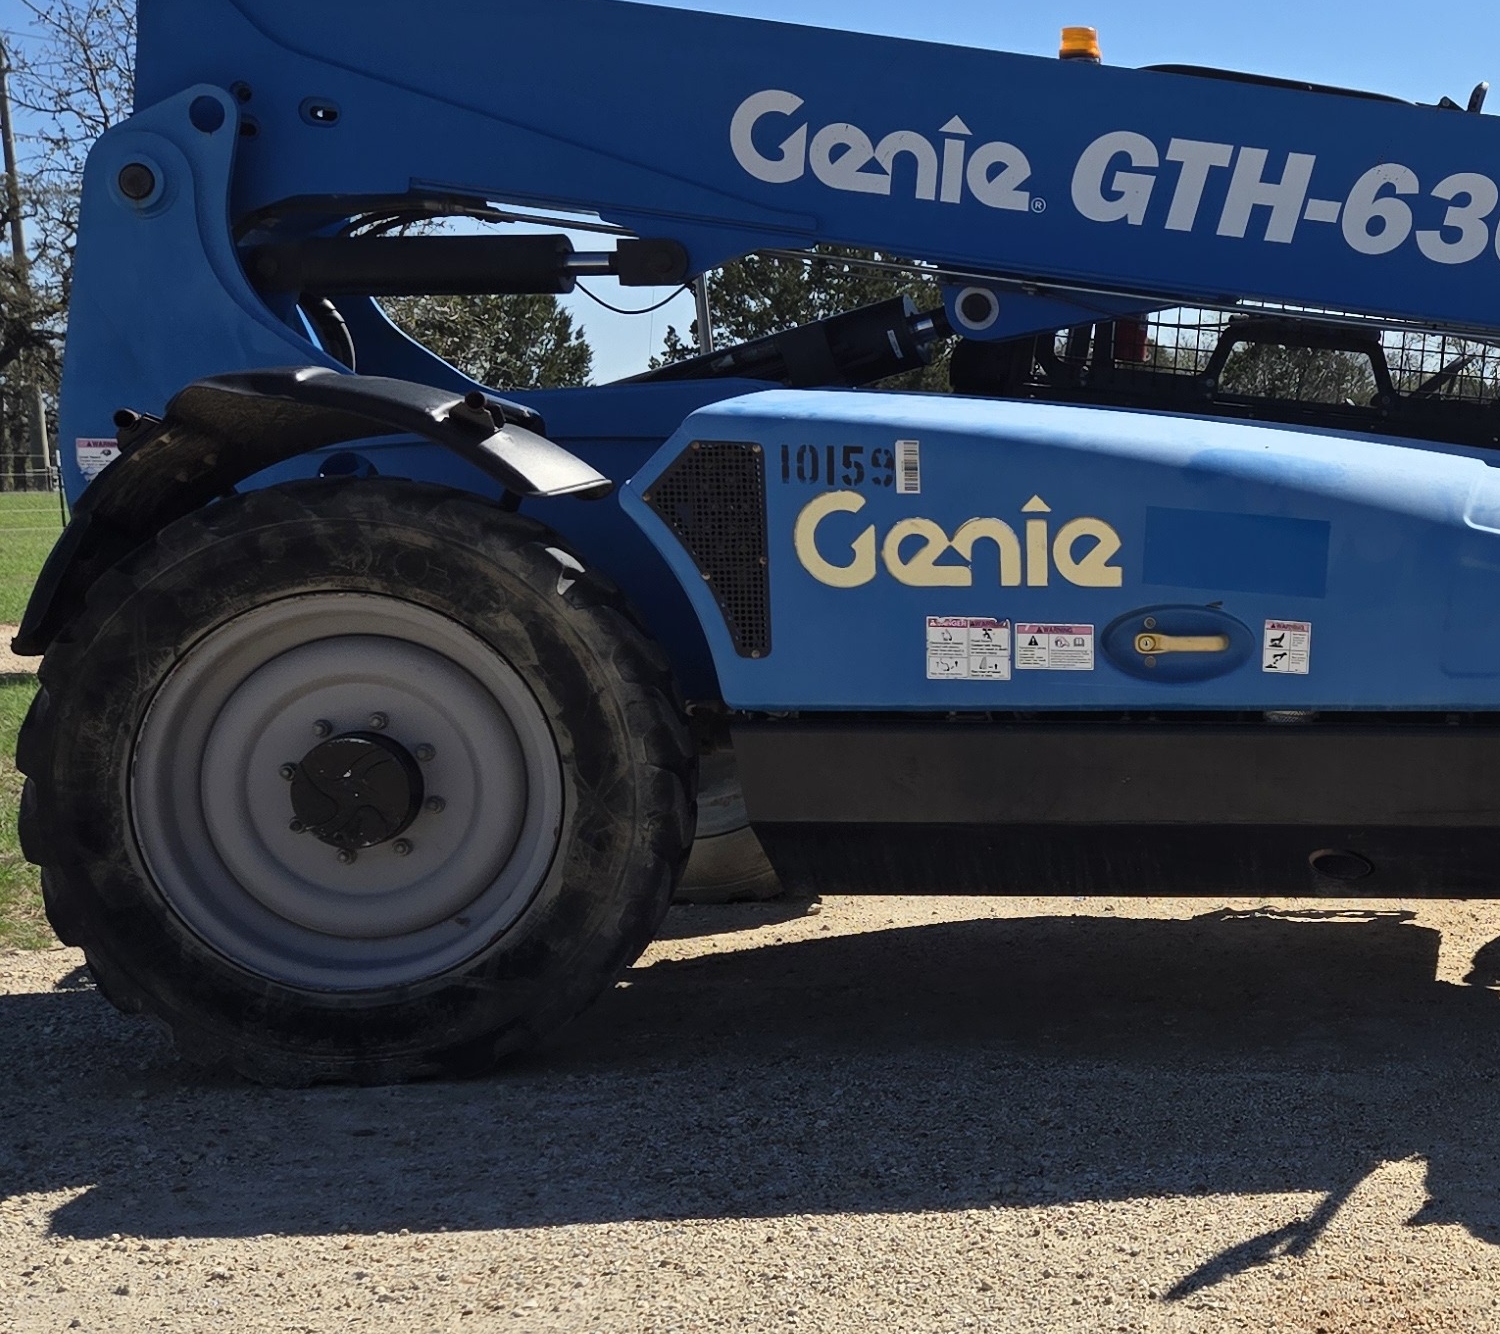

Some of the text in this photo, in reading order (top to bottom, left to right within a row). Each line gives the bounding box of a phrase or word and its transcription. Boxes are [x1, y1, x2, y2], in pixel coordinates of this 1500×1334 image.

[730, 90, 1032, 211] Genie
[92, 440, 118, 448] WARNIN
[781, 444, 894, 487] 10159
[794, 489, 1123, 588] Genie
